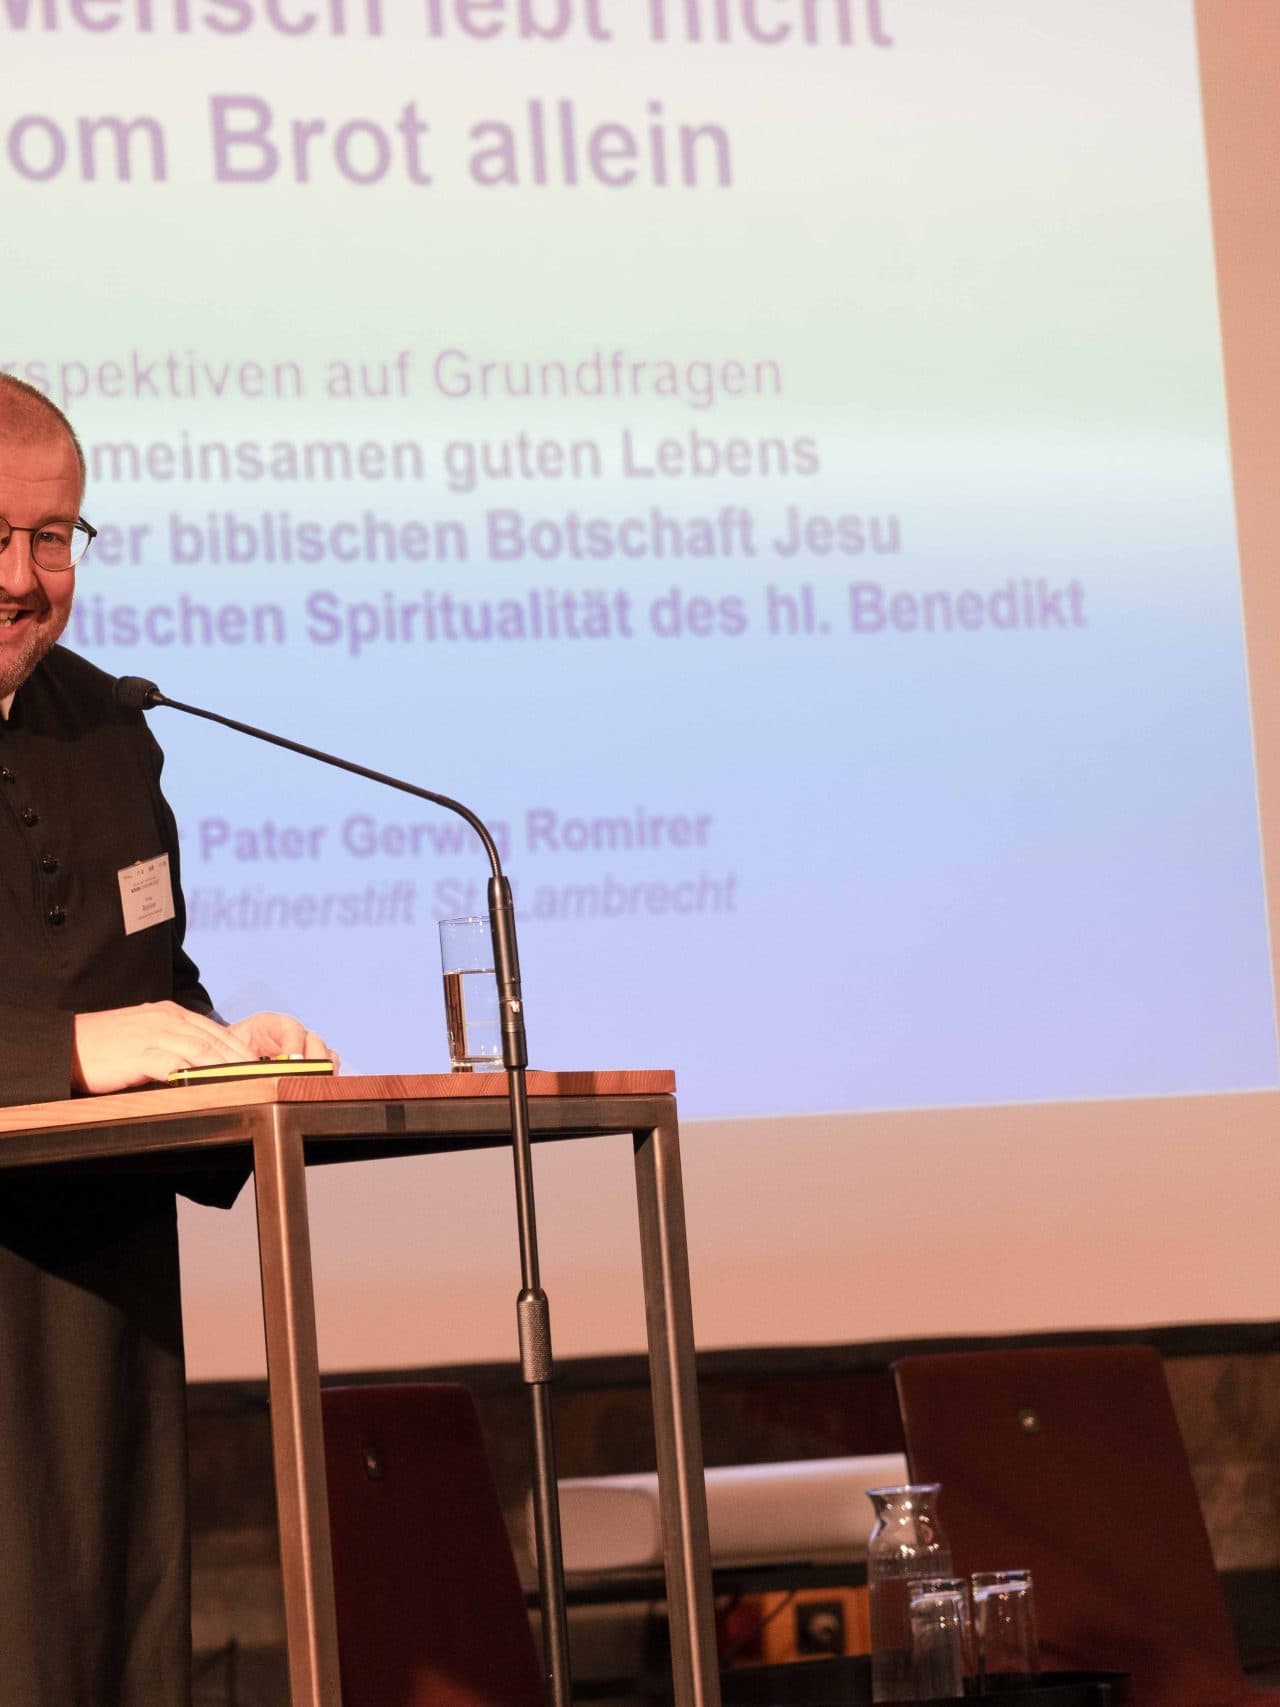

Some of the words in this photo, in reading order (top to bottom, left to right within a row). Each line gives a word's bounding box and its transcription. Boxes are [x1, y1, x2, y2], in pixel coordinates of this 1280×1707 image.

[209, 93, 433, 186] Brot
[468, 98, 733, 188] allein
[326, 348, 412, 399] auf
[431, 346, 784, 411] Grundfragen
[443, 431, 602, 494] guten
[620, 427, 822, 479] Lebens
[168, 509, 468, 566] biblischen
[484, 505, 756, 562] Botschaft
[773, 505, 902, 558] Jesu
[305, 587, 633, 657] Spiritualität
[649, 586, 749, 639] des
[765, 583, 830, 636] hl.
[848, 578, 1087, 634] Benedikt
[198, 816, 326, 863] Pater
[525, 805, 713, 854] Romirer
